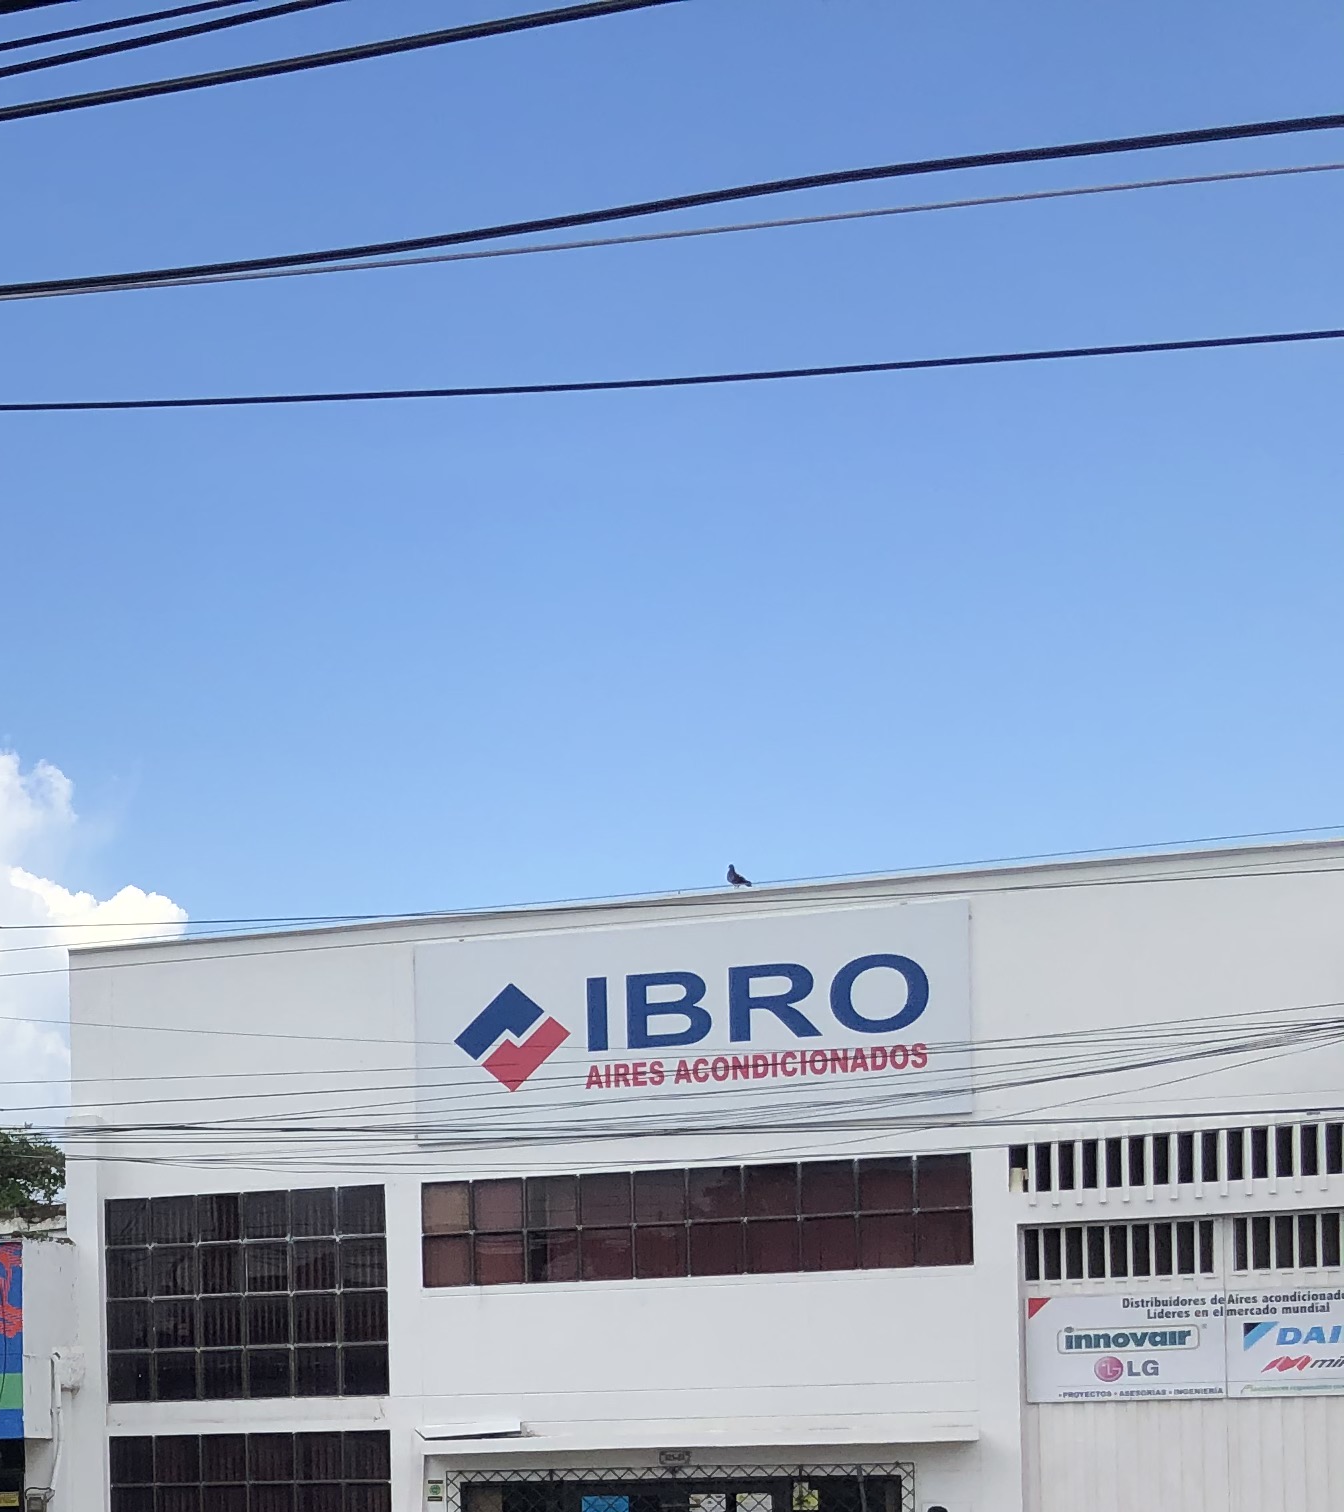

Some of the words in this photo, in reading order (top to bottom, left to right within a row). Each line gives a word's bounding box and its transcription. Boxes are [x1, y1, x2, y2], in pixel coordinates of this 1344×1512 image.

[586, 953, 929, 1052] IBRO
[586, 1060, 665, 1090] AIRES
[674, 1043, 928, 1084] ACONDICIONADOS
[1122, 1296, 1206, 1309] Distribuidores
[1210, 1294, 1224, 1305] de
[1227, 1293, 1257, 1305] Aires
[1262, 1290, 1344, 1303] acondicionad
[1195, 1309, 1208, 1318] en
[1213, 1306, 1223, 1317] el
[1226, 1304, 1277, 1317] mercado
[1282, 1302, 1330, 1315] mundial
[1064, 1326, 1192, 1350] innovair
[1276, 1326, 1344, 1346] DAI
[1127, 1360, 1160, 1377] LG
